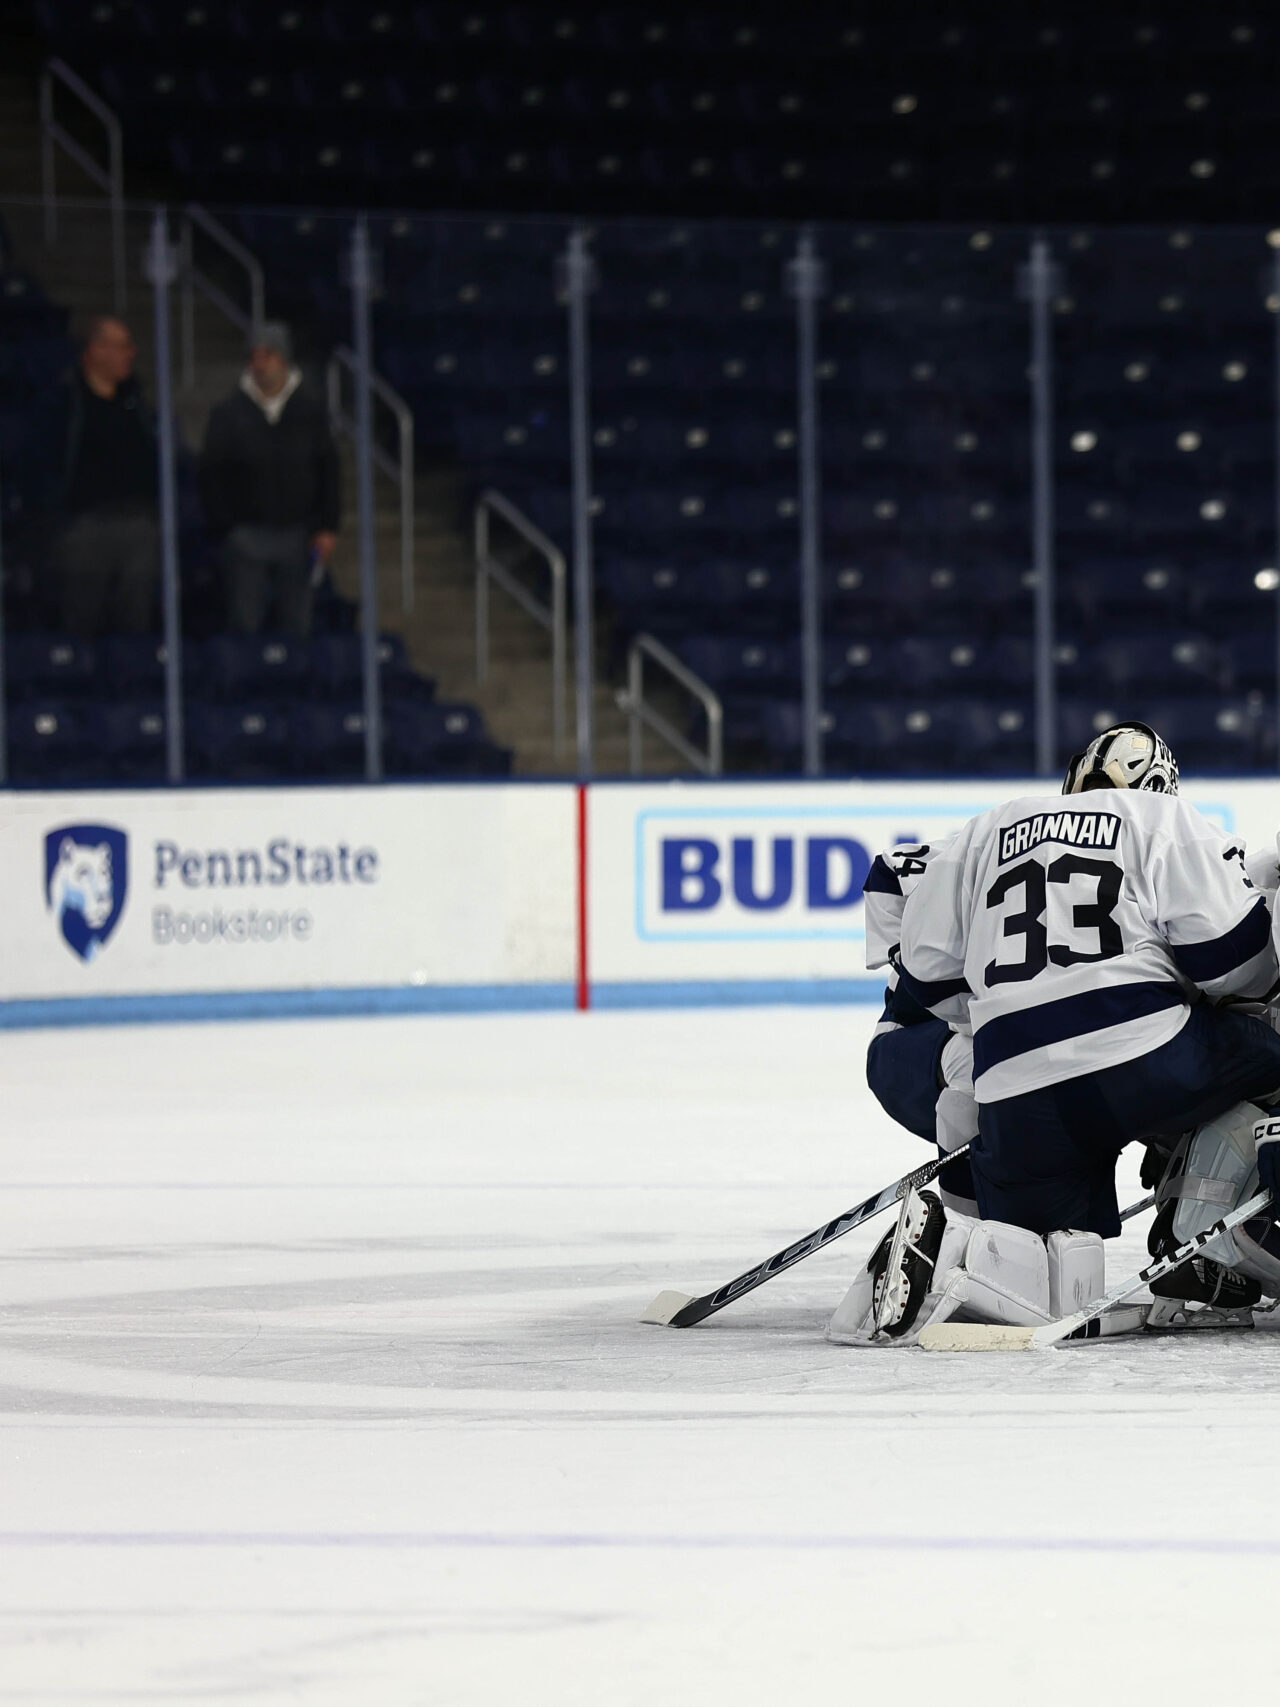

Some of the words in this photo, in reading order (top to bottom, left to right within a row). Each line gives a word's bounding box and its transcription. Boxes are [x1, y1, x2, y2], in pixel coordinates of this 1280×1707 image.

[1001, 814, 1118, 861] GRANNAN
[154, 839, 379, 887] PennState
[660, 837, 869, 914] BUD
[154, 904, 312, 944] Bookstore
[984, 852, 1124, 988] 33
